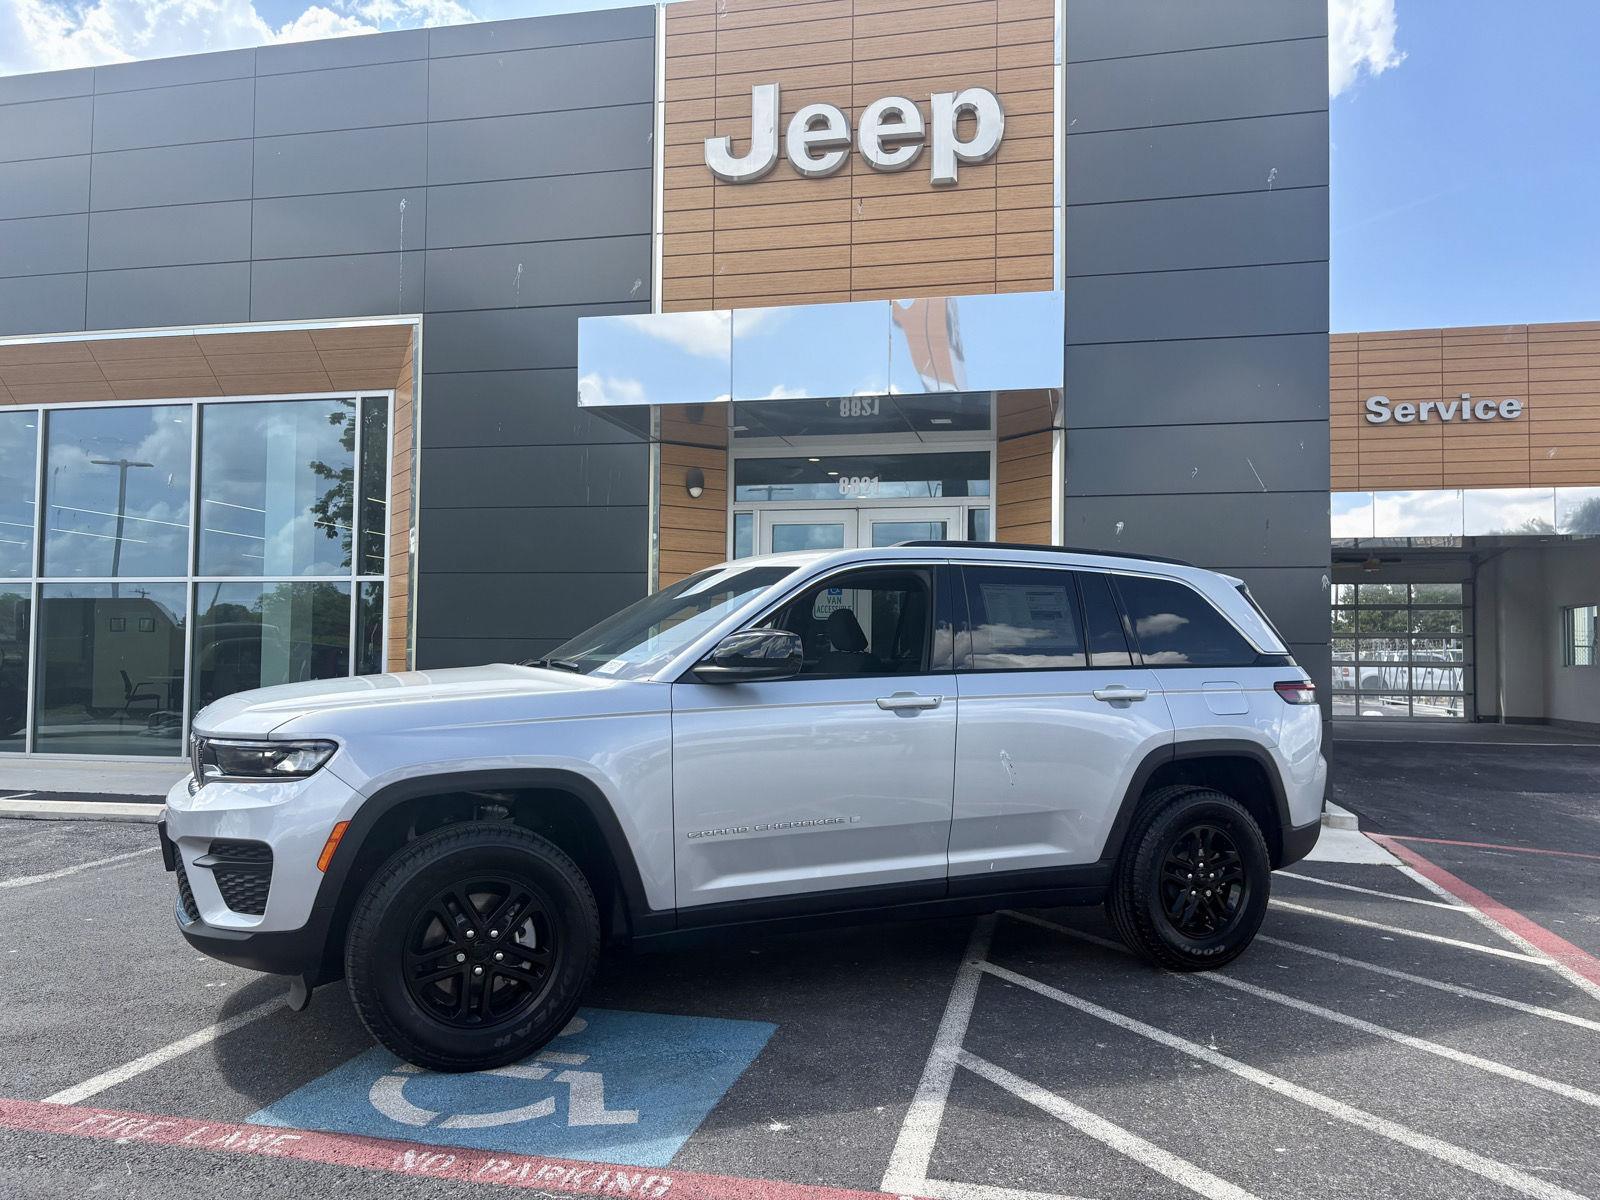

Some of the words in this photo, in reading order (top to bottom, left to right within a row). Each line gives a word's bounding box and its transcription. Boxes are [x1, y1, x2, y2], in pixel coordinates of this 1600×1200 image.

[704, 82, 1006, 186] Jeep
[1365, 392, 1523, 424] Service
[838, 476, 880, 495] 8821
[827, 596, 842, 605] VAN
[687, 826, 749, 839] GRAND
[754, 817, 846, 832] CHEROKEE
[394, 1149, 457, 1172] NO
[476, 1158, 674, 1198] PARKING
